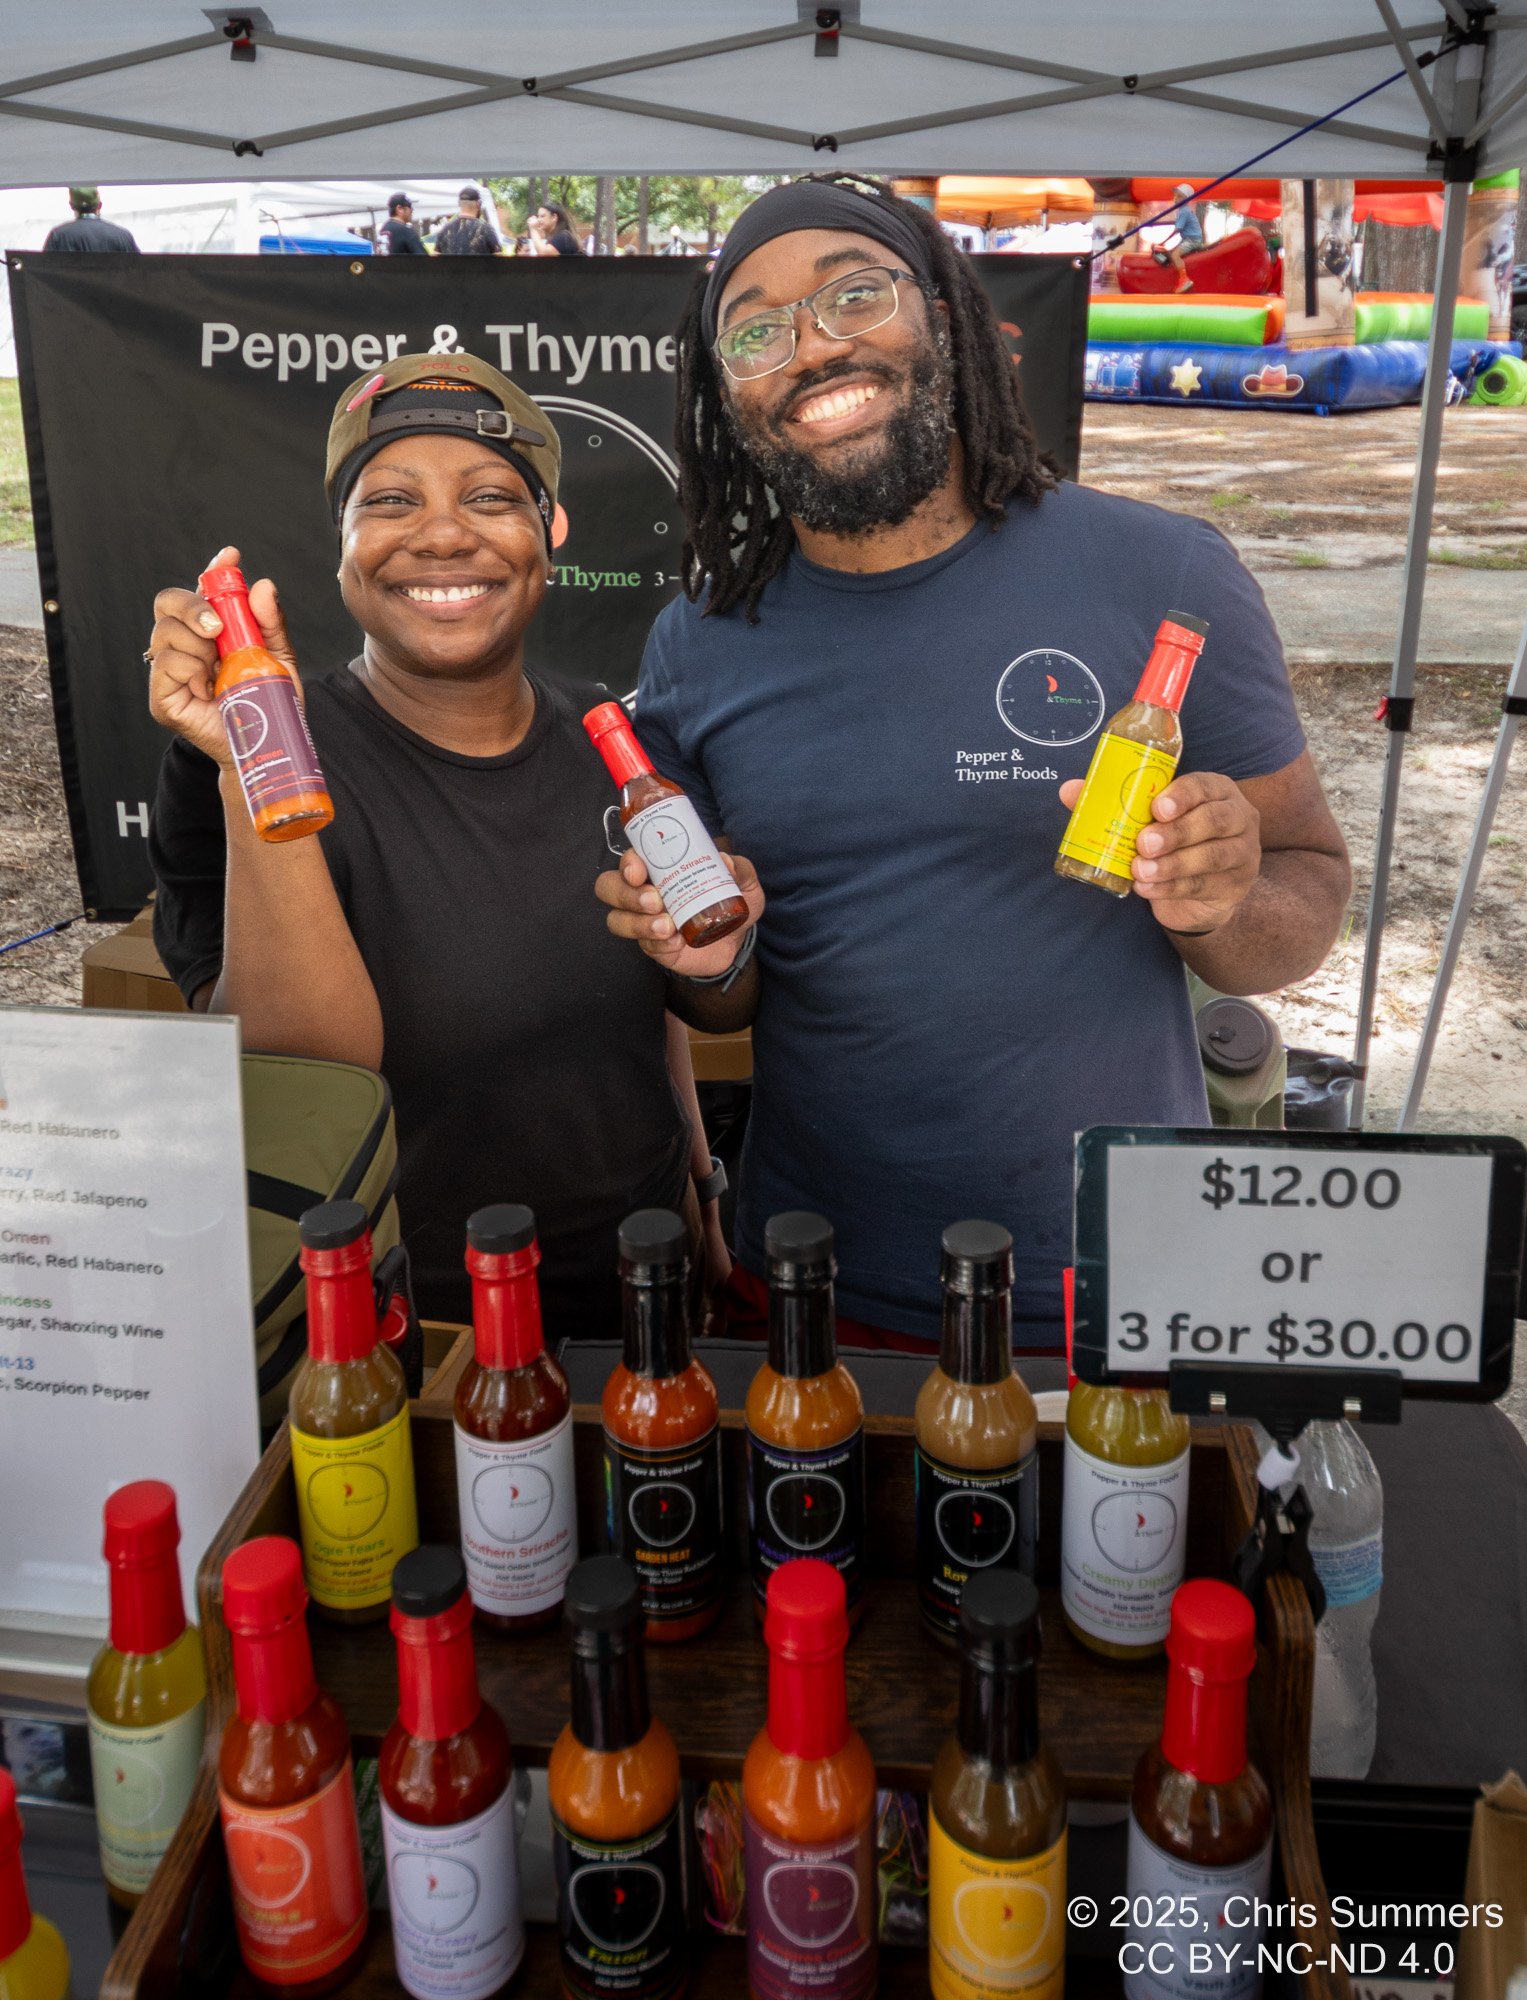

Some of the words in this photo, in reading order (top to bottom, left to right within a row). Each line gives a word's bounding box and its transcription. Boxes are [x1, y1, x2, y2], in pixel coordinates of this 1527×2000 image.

[200, 321, 407, 382] Pepper
[428, 323, 465, 354] &
[485, 322, 678, 385] Thyme
[956, 749, 1008, 768] Pepper
[1011, 748, 1024, 762] &
[955, 768, 1008, 784] Thyme
[1013, 766, 1058, 781] Foods
[680, 854, 712, 873] Sriracha
[0, 1119, 32, 1134] Red
[38, 1122, 120, 1141] Habanero
[0, 1167, 34, 1182] razy
[1201, 1156, 1402, 1210] $12.00
[0, 1189, 28, 1203] rry,
[33, 1188, 66, 1204] Red
[1, 1229, 51, 1246] Omen
[0, 1252, 42, 1269] arlic,
[46, 1254, 78, 1269] Red
[84, 1257, 165, 1276] Habanero
[1261, 1249, 1323, 1284] or
[0, 1316, 36, 1332] egar,
[40, 1317, 118, 1339] Shaoxing
[122, 1323, 165, 1340] Wine
[1117, 1311, 1150, 1353] 3
[1166, 1312, 1251, 1355] for
[1265, 1312, 1473, 1364] $30.00
[14, 1377, 88, 1396] Scorpion
[92, 1383, 150, 1401] Pepper
[658, 1465, 684, 1478] Thyme
[764, 1454, 791, 1471] Pepper
[791, 1462, 799, 1472] &
[800, 1461, 827, 1472] Thyme
[828, 1451, 850, 1468] Foods
[932, 1469, 961, 1486] Pepper
[961, 1479, 969, 1488] &
[971, 1480, 1000, 1490] Thyme
[1002, 1470, 1025, 1486] Foods
[1091, 1470, 1120, 1485] Pepper
[1121, 1480, 1128, 1488] &
[1131, 1480, 1158, 1490] Thyme
[1159, 1471, 1180, 1486] Foods
[463, 1533, 516, 1559] Southern
[518, 1528, 570, 1558] Sriracha
[942, 1562, 969, 1584] Roy
[1081, 1560, 1134, 1592] Creamy
